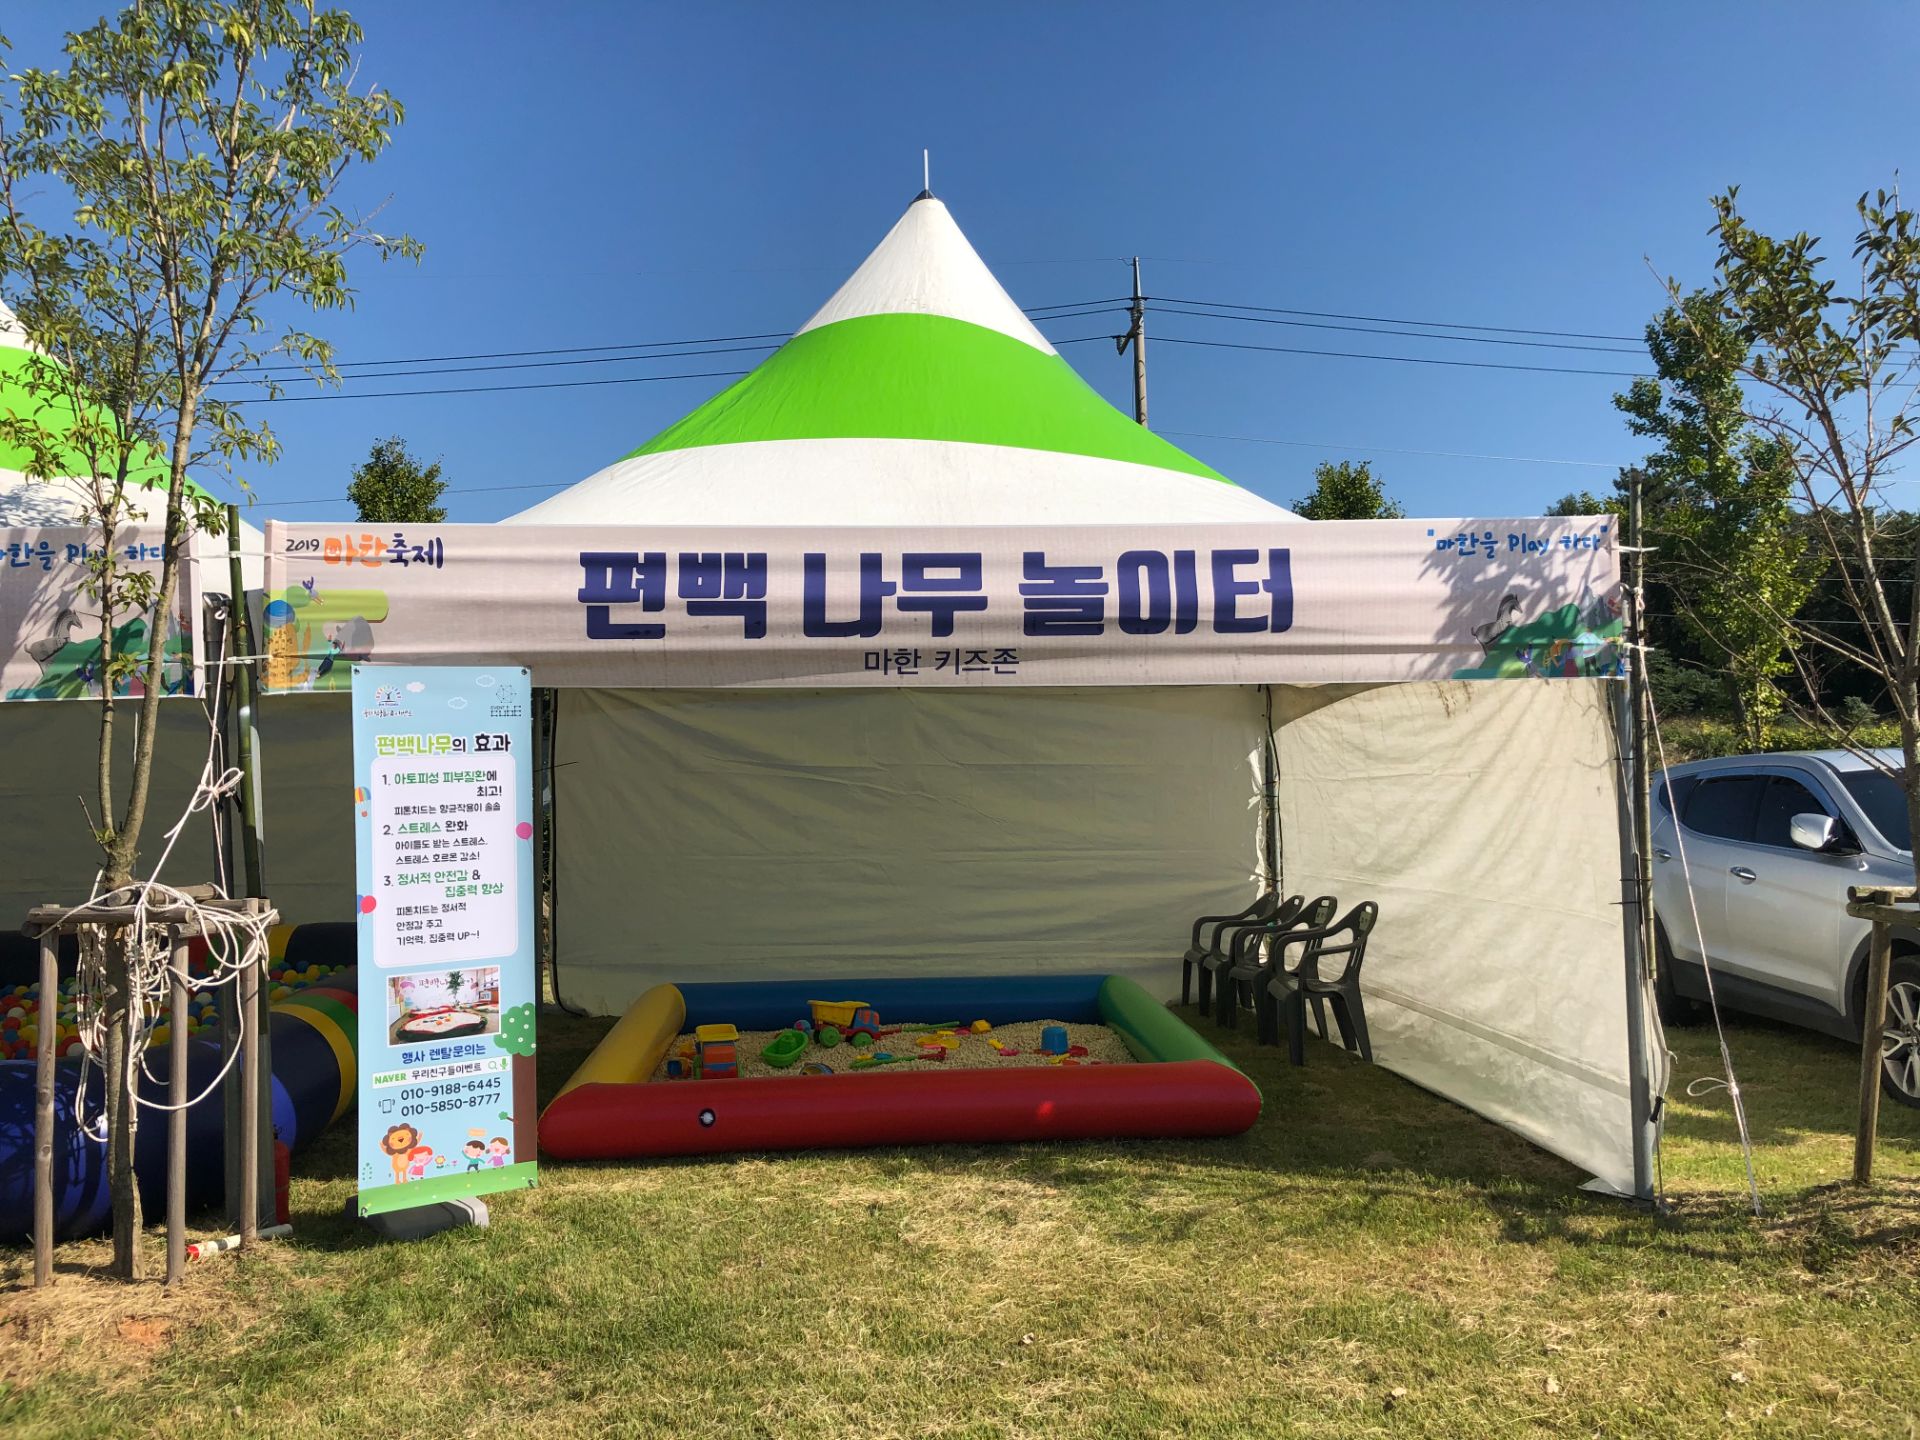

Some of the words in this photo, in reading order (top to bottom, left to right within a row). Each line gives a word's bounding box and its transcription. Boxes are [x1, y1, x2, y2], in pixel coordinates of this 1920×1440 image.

[285, 539, 320, 551] 2019
[323, 533, 444, 568] 마한축제
[1508, 533, 1550, 556] Play
[576, 551, 770, 640] 편백
[1017, 548, 1294, 638] 놀이터
[864, 648, 919, 676] 마한
[934, 647, 1021, 675] 키즈존
[377, 735, 466, 755] 편백나무의
[474, 733, 511, 752] 효과
[382, 775, 391, 785] 1.
[395, 773, 439, 785] 아토피성
[443, 770, 497, 783] 피부질환에
[477, 786, 502, 797] 최고!
[394, 805, 437, 815] 피톤치드는
[383, 825, 394, 836] 2.
[398, 822, 441, 834] 스트레스
[445, 820, 468, 832] 완화
[396, 840, 430, 850] 아이들도
[433, 839, 450, 848] 받는
[396, 855, 429, 864] 스트레스
[432, 853, 457, 862] 호르몬
[460, 852, 480, 861] 감소!
[383, 876, 394, 886] 3.
[398, 872, 431, 885] 정서적
[472, 870, 480, 880] &
[445, 885, 477, 897] 집중력
[482, 883, 503, 895] 향상
[396, 905, 438, 916] 피톤치드는
[441, 903, 467, 912] 정서적
[396, 920, 423, 931] 안정감
[426, 919, 442, 928] 주고
[429, 932, 455, 943] 집중력
[458, 931, 480, 940] UP~!
[402, 1050, 425, 1065] 행사
[429, 1043, 486, 1061] 렌탈문의는
[374, 1073, 406, 1085] NAVER
[412, 1062, 481, 1080] 우리친구들이벤트
[401, 1077, 501, 1100] 010-9188-6445
[401, 1093, 501, 1117] 010-5850-8777
